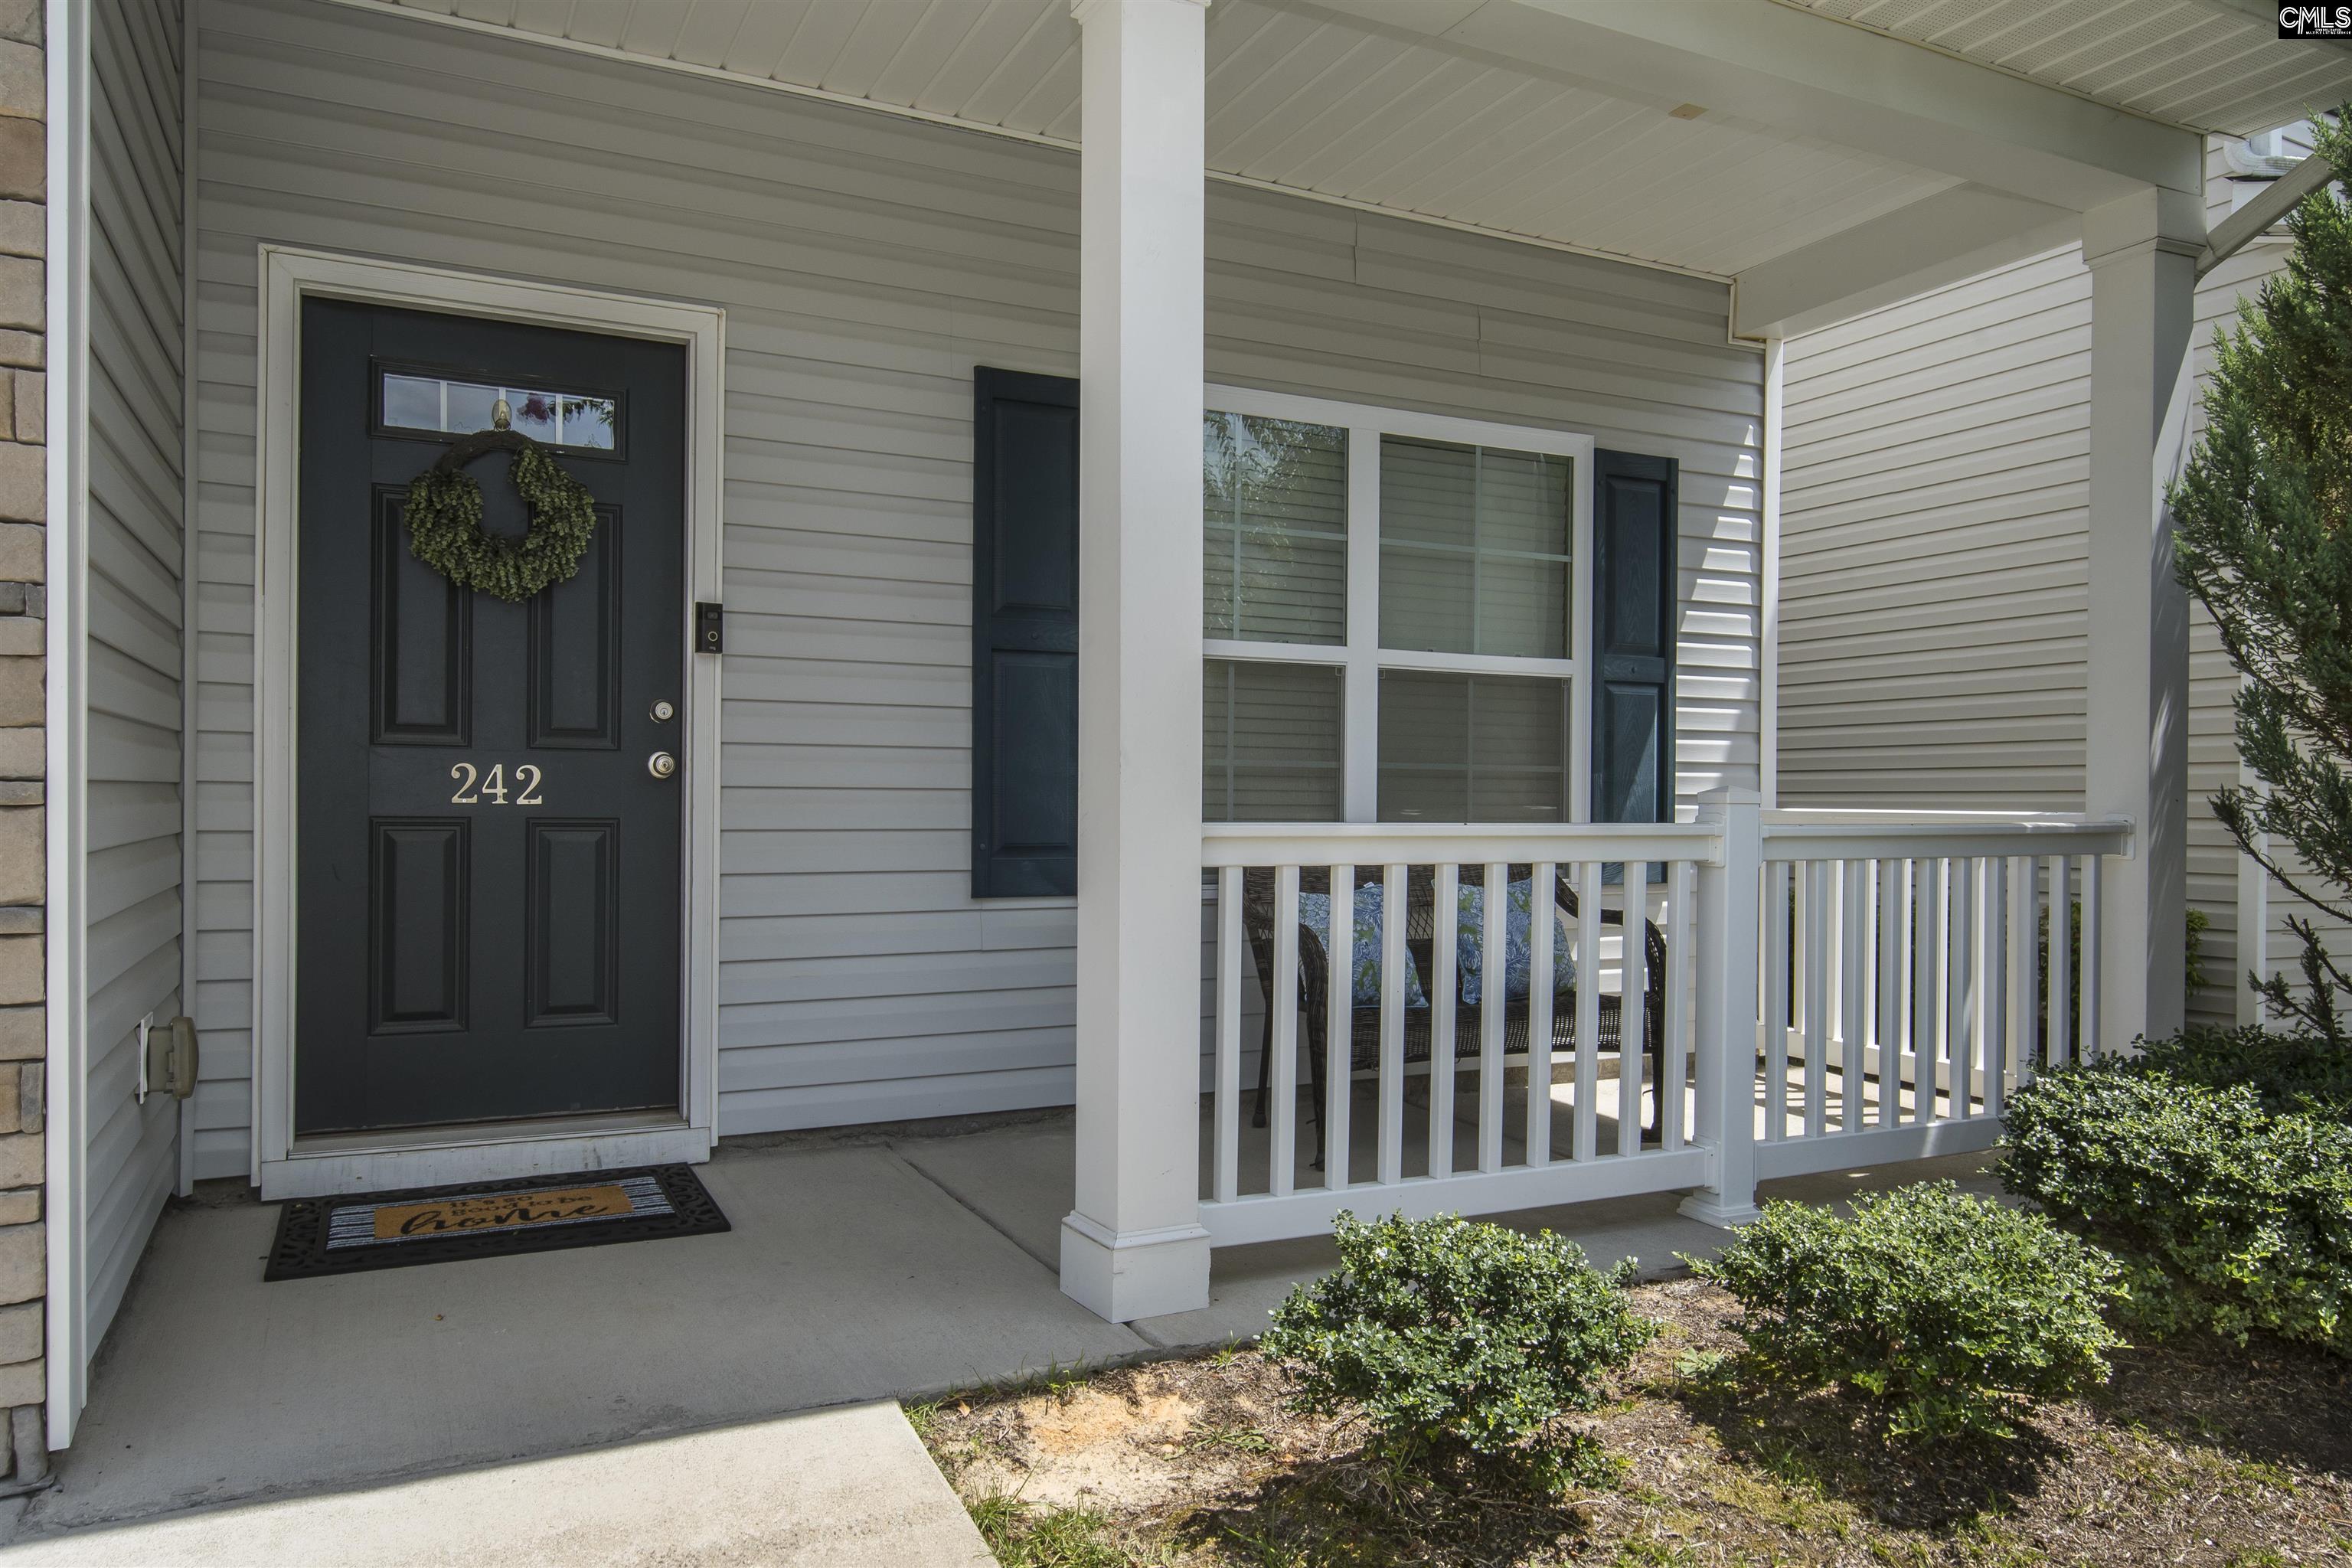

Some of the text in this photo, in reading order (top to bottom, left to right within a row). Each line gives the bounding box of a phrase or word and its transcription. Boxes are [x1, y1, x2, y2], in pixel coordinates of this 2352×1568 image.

[451, 763, 542, 805] 242
[400, 1205, 609, 1234] home
[452, 1201, 518, 1216] good
